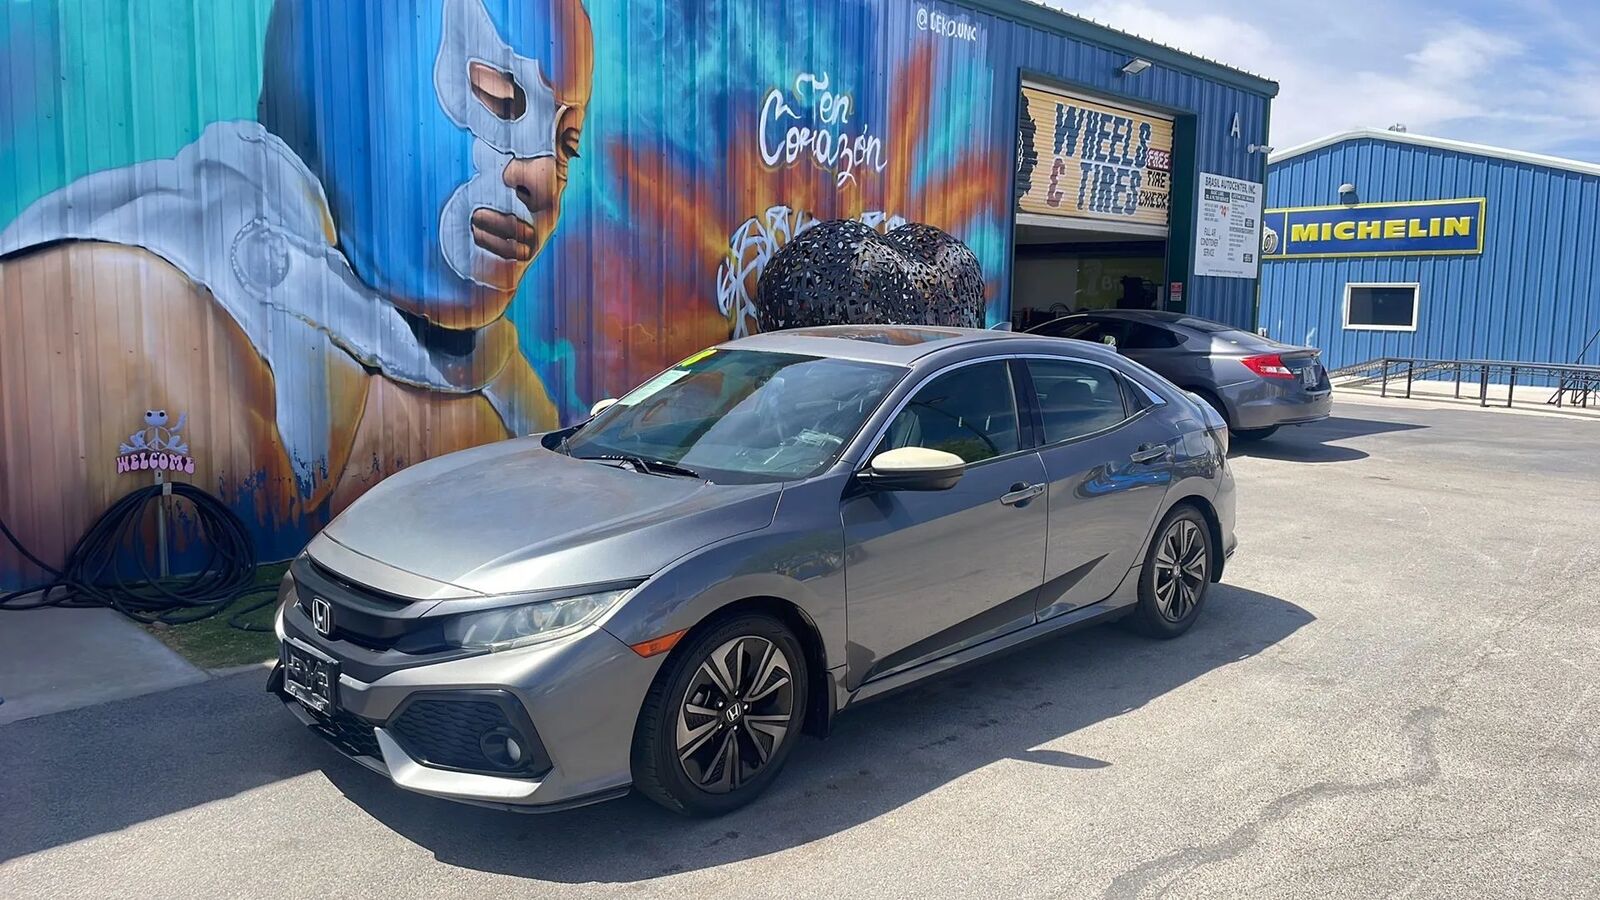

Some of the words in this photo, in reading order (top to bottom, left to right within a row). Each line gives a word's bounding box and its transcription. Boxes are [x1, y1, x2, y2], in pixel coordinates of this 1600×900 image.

[796, 71, 850, 124] Ten
[759, 88, 888, 187] Corazón
[1053, 102, 1151, 169] WHEELS
[1230, 111, 1240, 139] A
[1146, 149, 1170, 169] FREE
[1077, 161, 1143, 216] TIRES
[1146, 170, 1168, 188] TIRE
[1138, 190, 1168, 210] CHECK
[1291, 216, 1471, 242] MICHELIN
[116, 452, 195, 474] WELCOME
